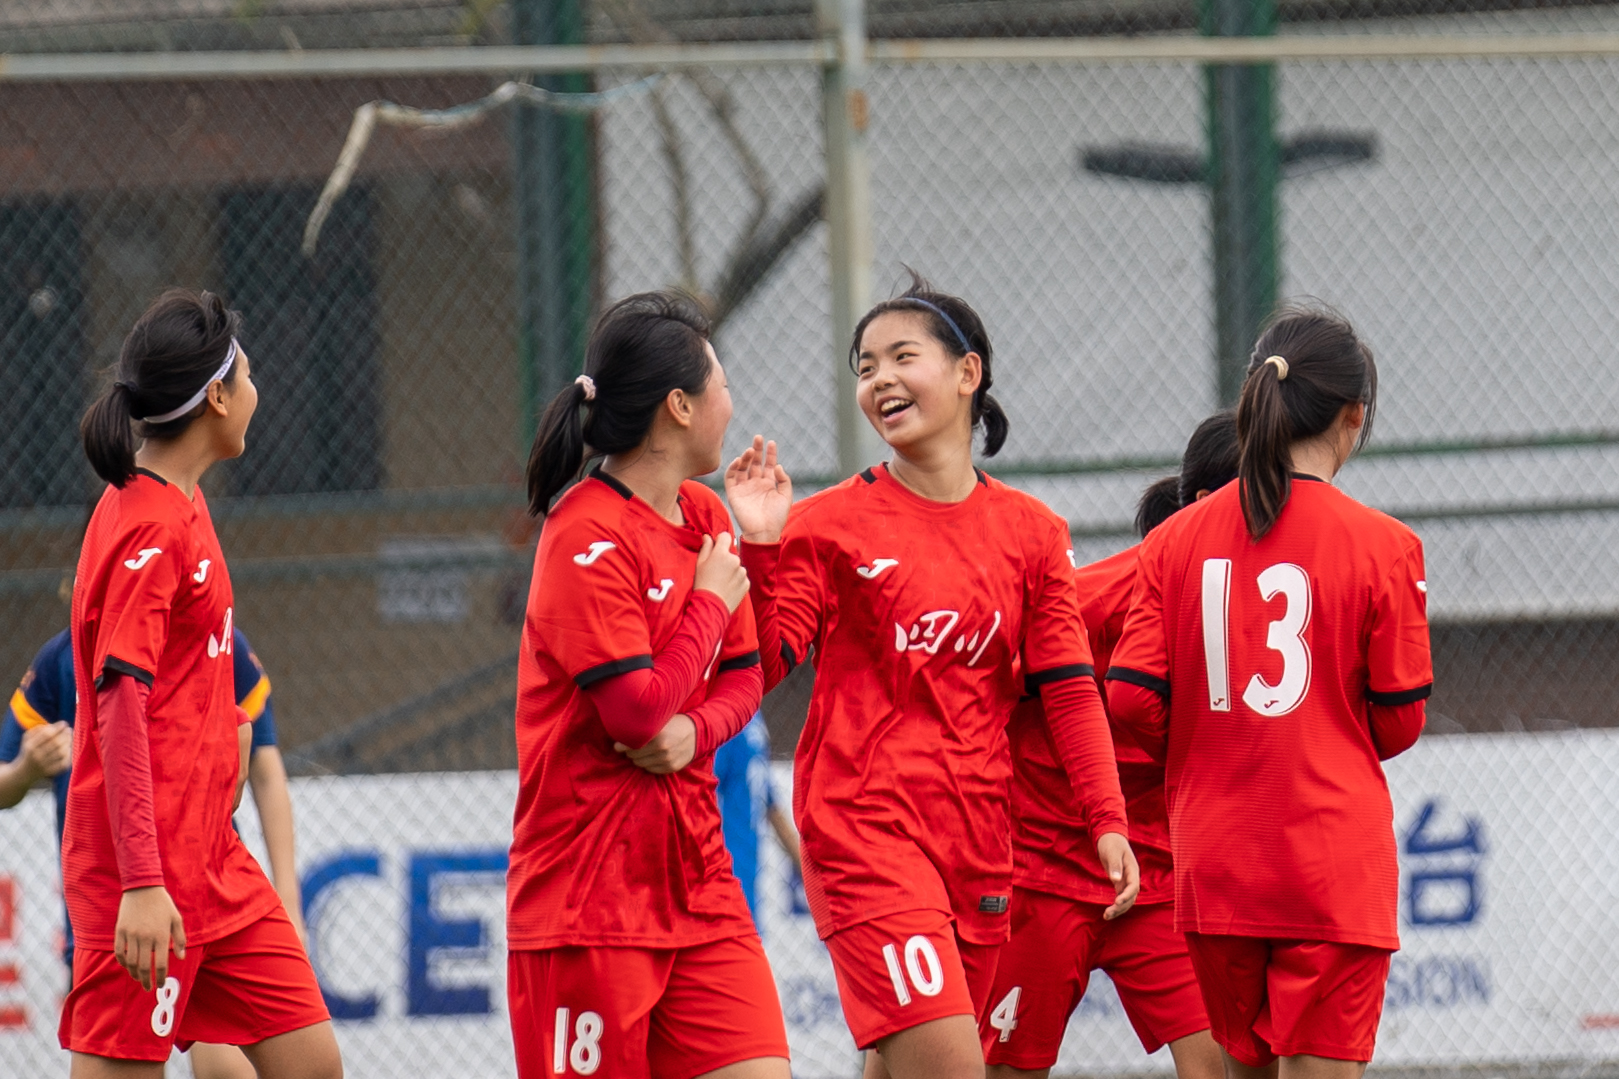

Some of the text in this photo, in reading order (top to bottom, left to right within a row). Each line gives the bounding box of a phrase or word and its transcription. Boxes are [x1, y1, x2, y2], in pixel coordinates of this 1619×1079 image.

[1202, 558, 1313, 718] 13
[882, 935, 944, 1006] 10
[151, 976, 180, 1037] 8
[990, 986, 1022, 1042] 4
[553, 1007, 604, 1076] 18
